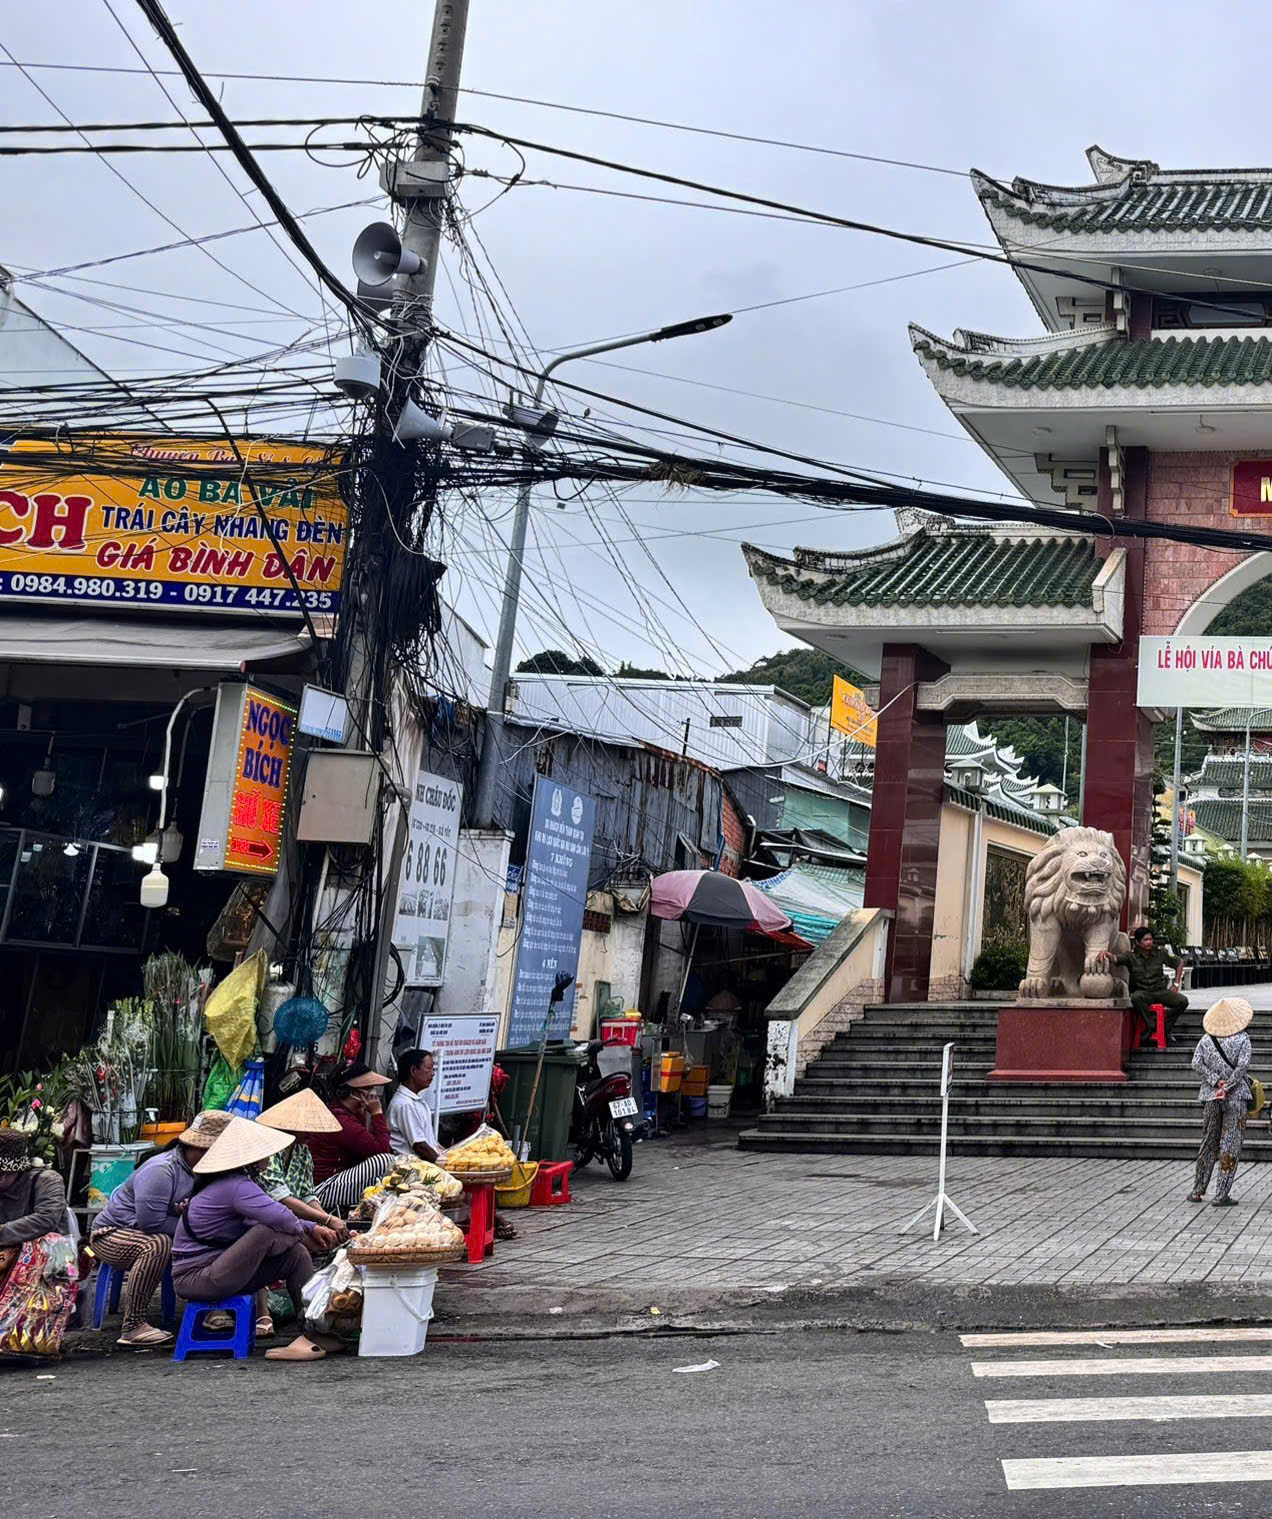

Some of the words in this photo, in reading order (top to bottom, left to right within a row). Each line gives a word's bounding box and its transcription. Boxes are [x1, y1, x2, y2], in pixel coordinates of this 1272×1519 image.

[102, 503, 154, 530] TRÁI
[161, 504, 206, 536] CÂY
[213, 513, 289, 542] NHANG
[296, 515, 343, 544] ĐÈN
[96, 537, 156, 573] GIÁ
[168, 540, 255, 578] BÌNH
[262, 548, 337, 584] DÂN
[11, 574, 163, 599] 0984.980.319
[184, 584, 236, 603] 0917
[1158, 641, 1172, 669] LỄ
[1175, 645, 1196, 672] HỘI
[1201, 645, 1222, 670] VÍA
[1227, 645, 1244, 670] BÀ
[246, 700, 292, 750] NGỌC
[243, 740, 284, 788] BÍCH
[416, 842, 430, 884] 88
[434, 846, 447, 887] 66
